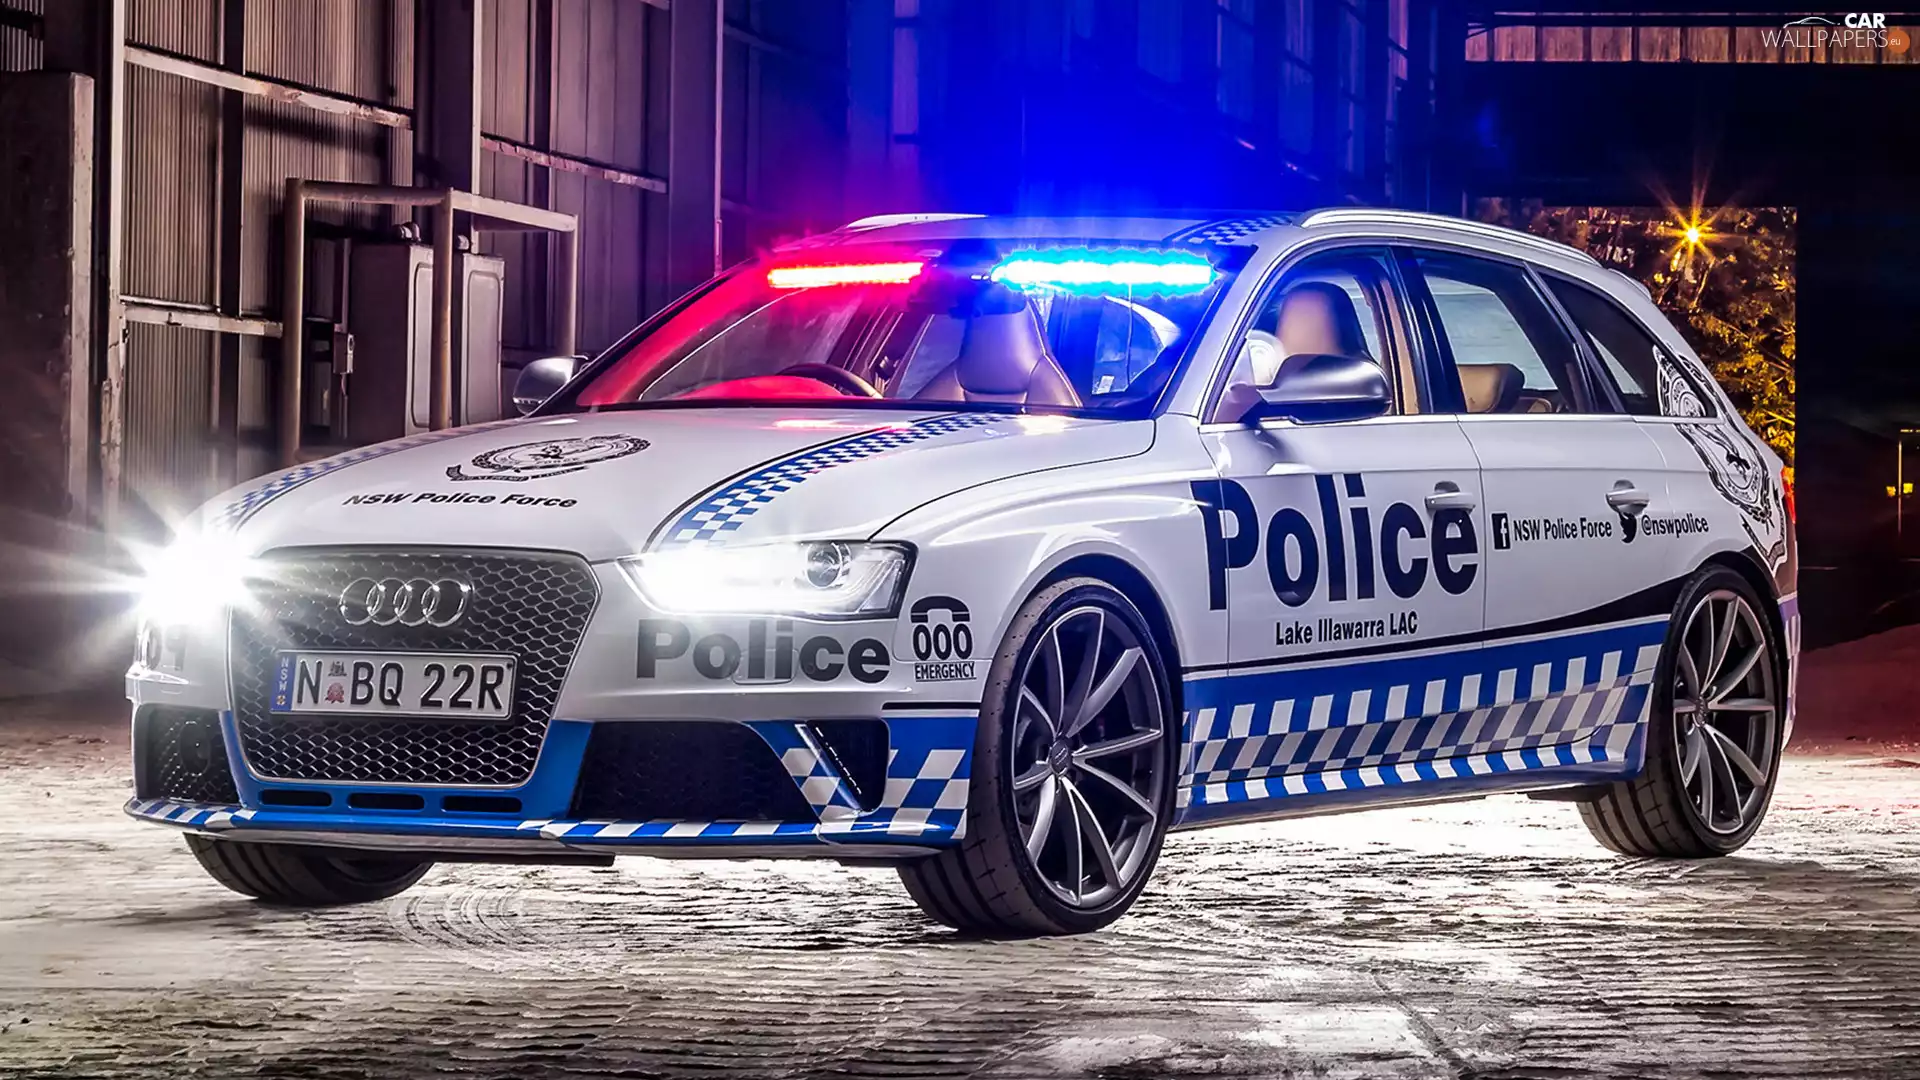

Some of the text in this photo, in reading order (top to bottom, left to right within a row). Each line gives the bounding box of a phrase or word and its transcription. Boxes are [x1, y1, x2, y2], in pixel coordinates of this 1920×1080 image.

[342, 492, 579, 508] NSW Police Force
[1190, 472, 1479, 611] Police
[1513, 516, 1613, 541] NSW Police Force
[1641, 513, 1710, 539] @nswpolice
[912, 623, 975, 662] 000
[1275, 611, 1418, 646] Lake Illawarra LAC
[636, 618, 891, 684] Police
[279, 656, 289, 692] NSW
[419, 661, 505, 710] 22R
[914, 661, 976, 681] EMERGENCY
